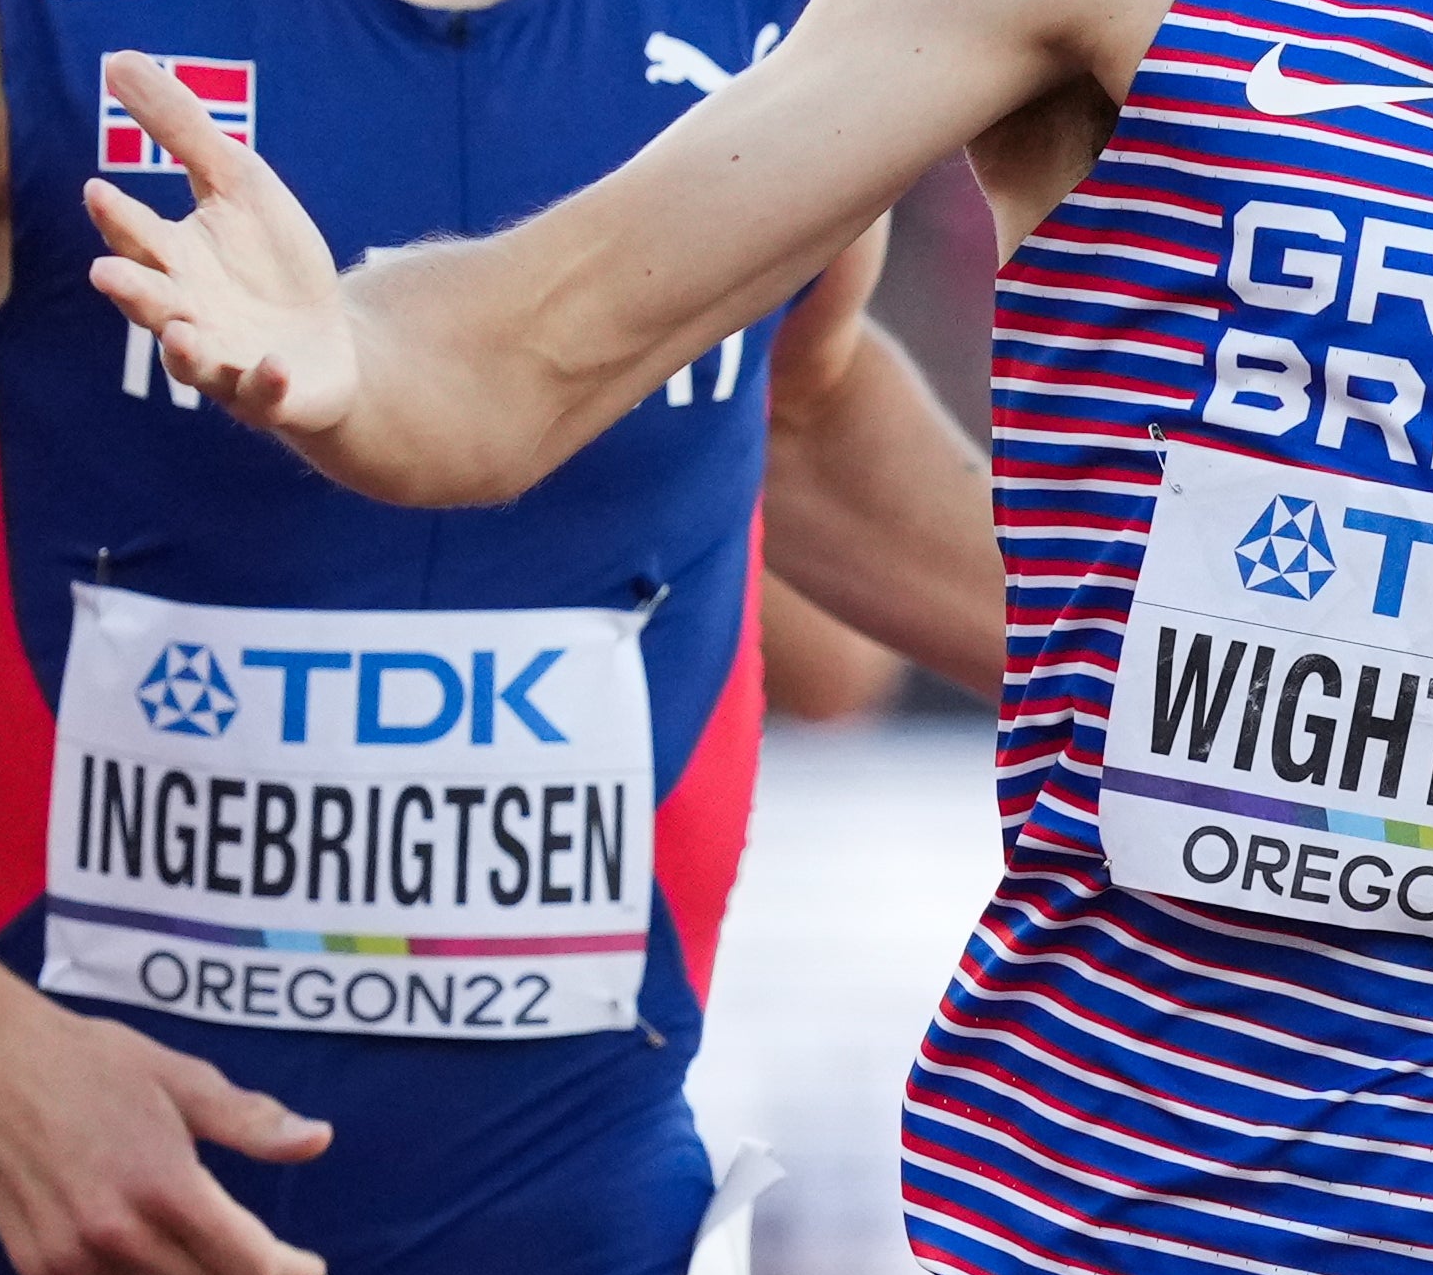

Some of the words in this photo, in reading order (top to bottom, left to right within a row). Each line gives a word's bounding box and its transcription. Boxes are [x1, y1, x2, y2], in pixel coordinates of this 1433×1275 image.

[241, 647, 570, 745] TDK
[76, 754, 626, 907] INGEBRIGTSEN
[138, 950, 552, 1027] OREGON22
